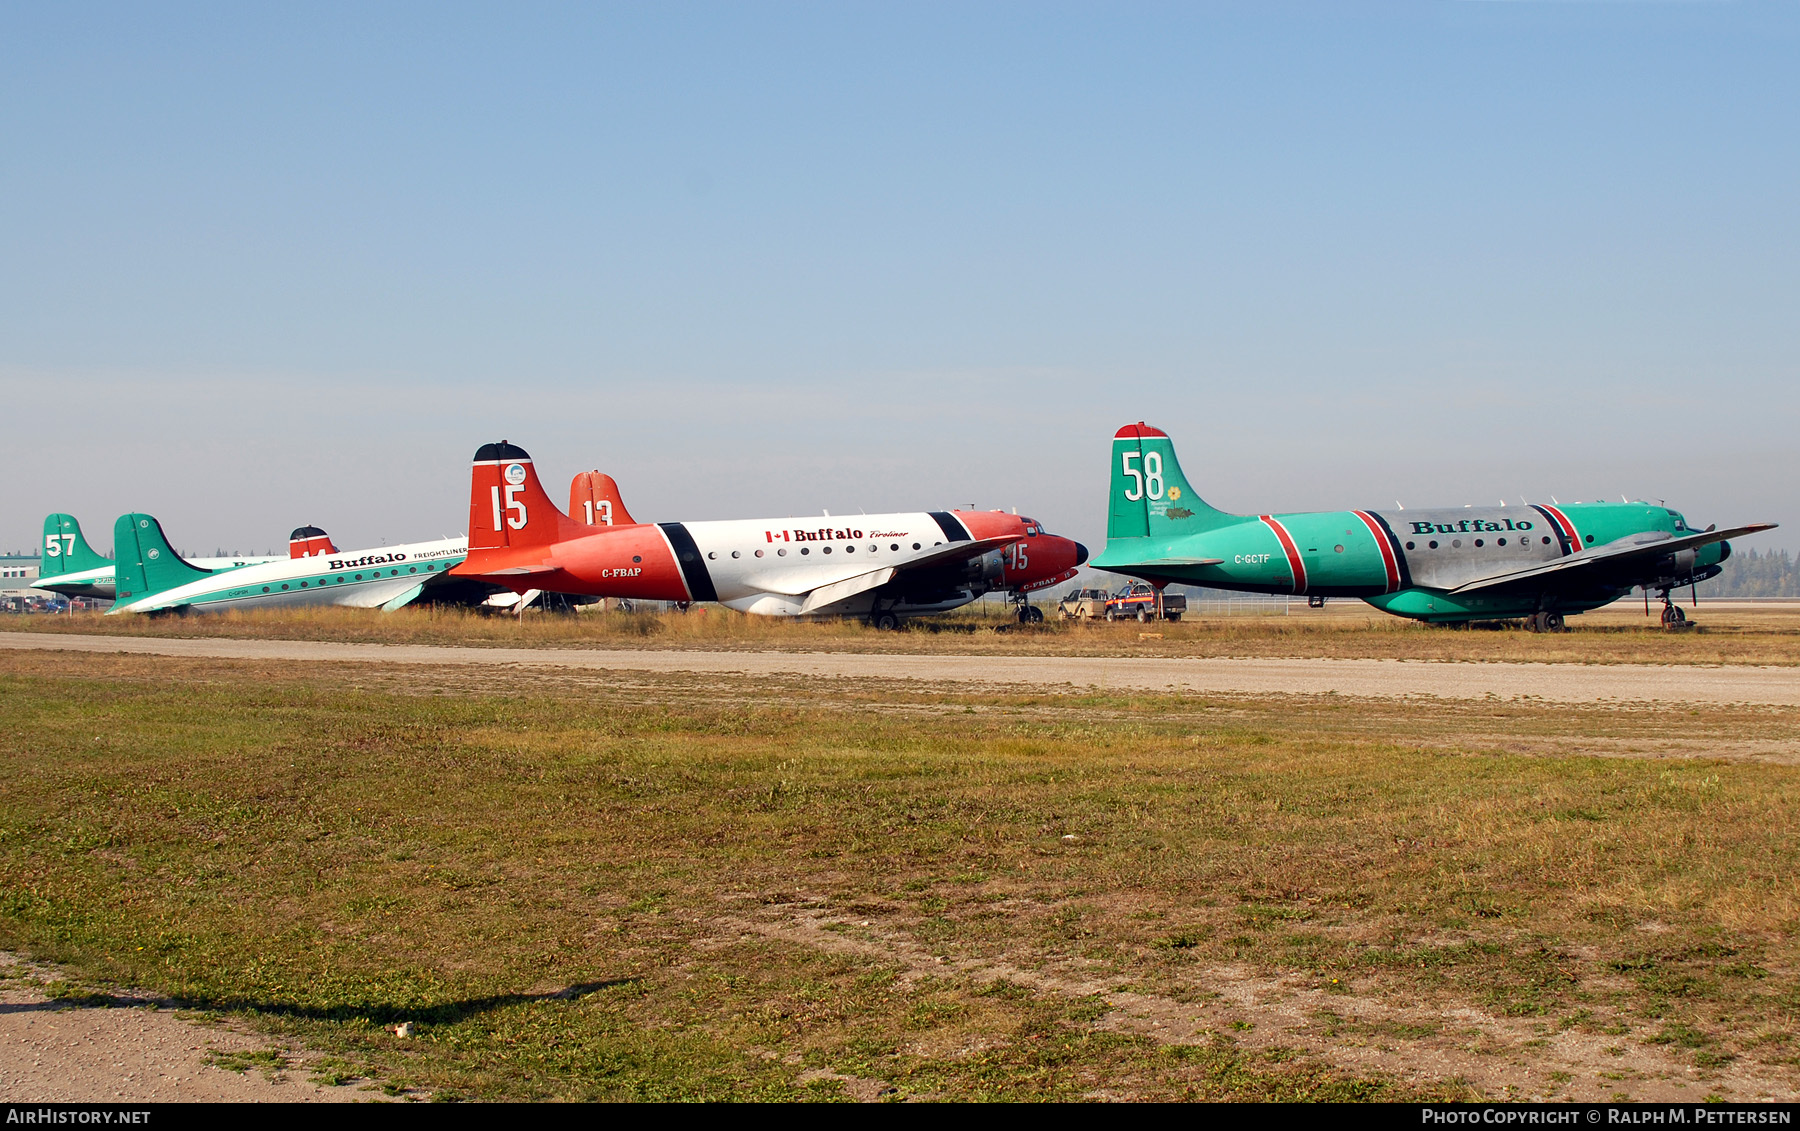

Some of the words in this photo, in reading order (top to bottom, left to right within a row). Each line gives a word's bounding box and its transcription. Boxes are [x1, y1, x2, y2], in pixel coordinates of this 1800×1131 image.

[1121, 450, 1164, 501] 58
[491, 484, 528, 531] 15
[583, 499, 613, 526] 13
[793, 527, 863, 541] Buffalo
[1409, 518, 1533, 535] Buffalo
[45, 533, 76, 558] 57
[1011, 543, 1029, 570] 15
[329, 552, 406, 570] Buffalo
[413, 547, 468, 559] FREIGHTLINER
[1234, 553, 1271, 564] C-GCTF
[601, 567, 642, 578] C-FBAP
[1023, 577, 1057, 590] C-FBAP
[1064, 571, 1071, 579] 15
